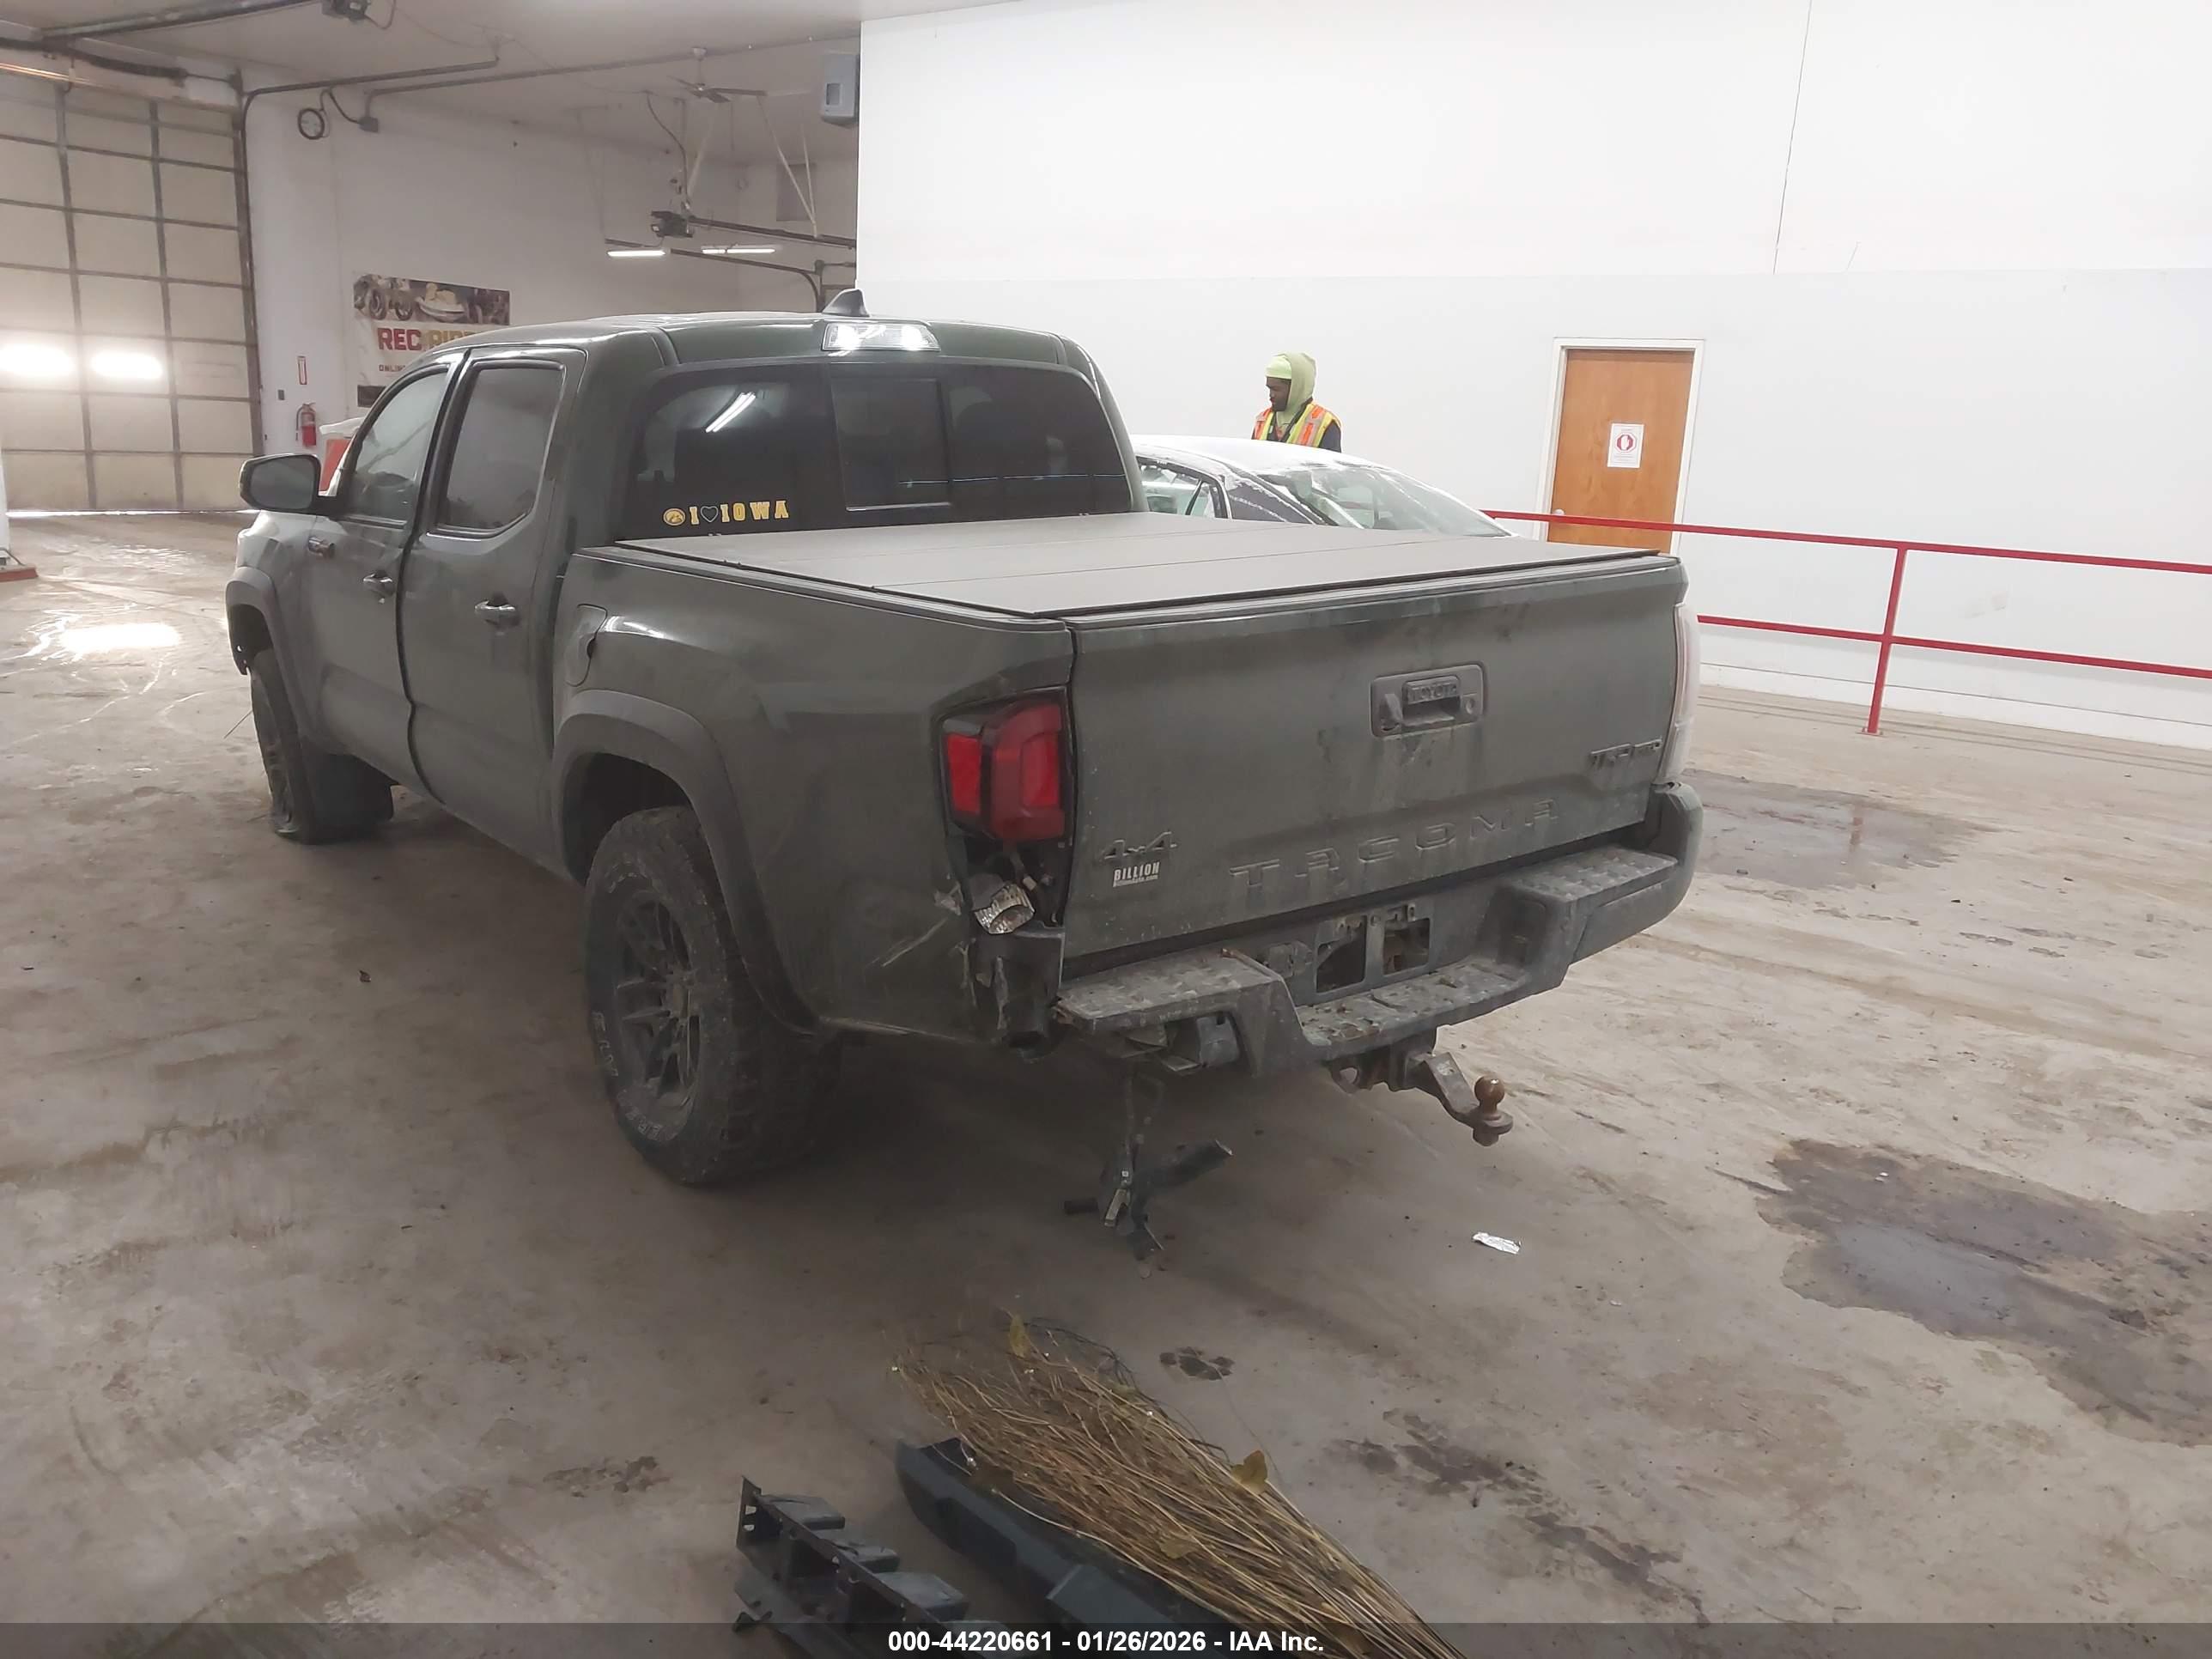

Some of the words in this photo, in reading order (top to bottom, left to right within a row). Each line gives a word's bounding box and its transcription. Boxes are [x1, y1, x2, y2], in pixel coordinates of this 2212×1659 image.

[378, 328, 422, 350] REC
[720, 500, 789, 523] IOWA
[1230, 799, 1559, 890] TACOMA
[1115, 861, 1160, 880] BILLION
